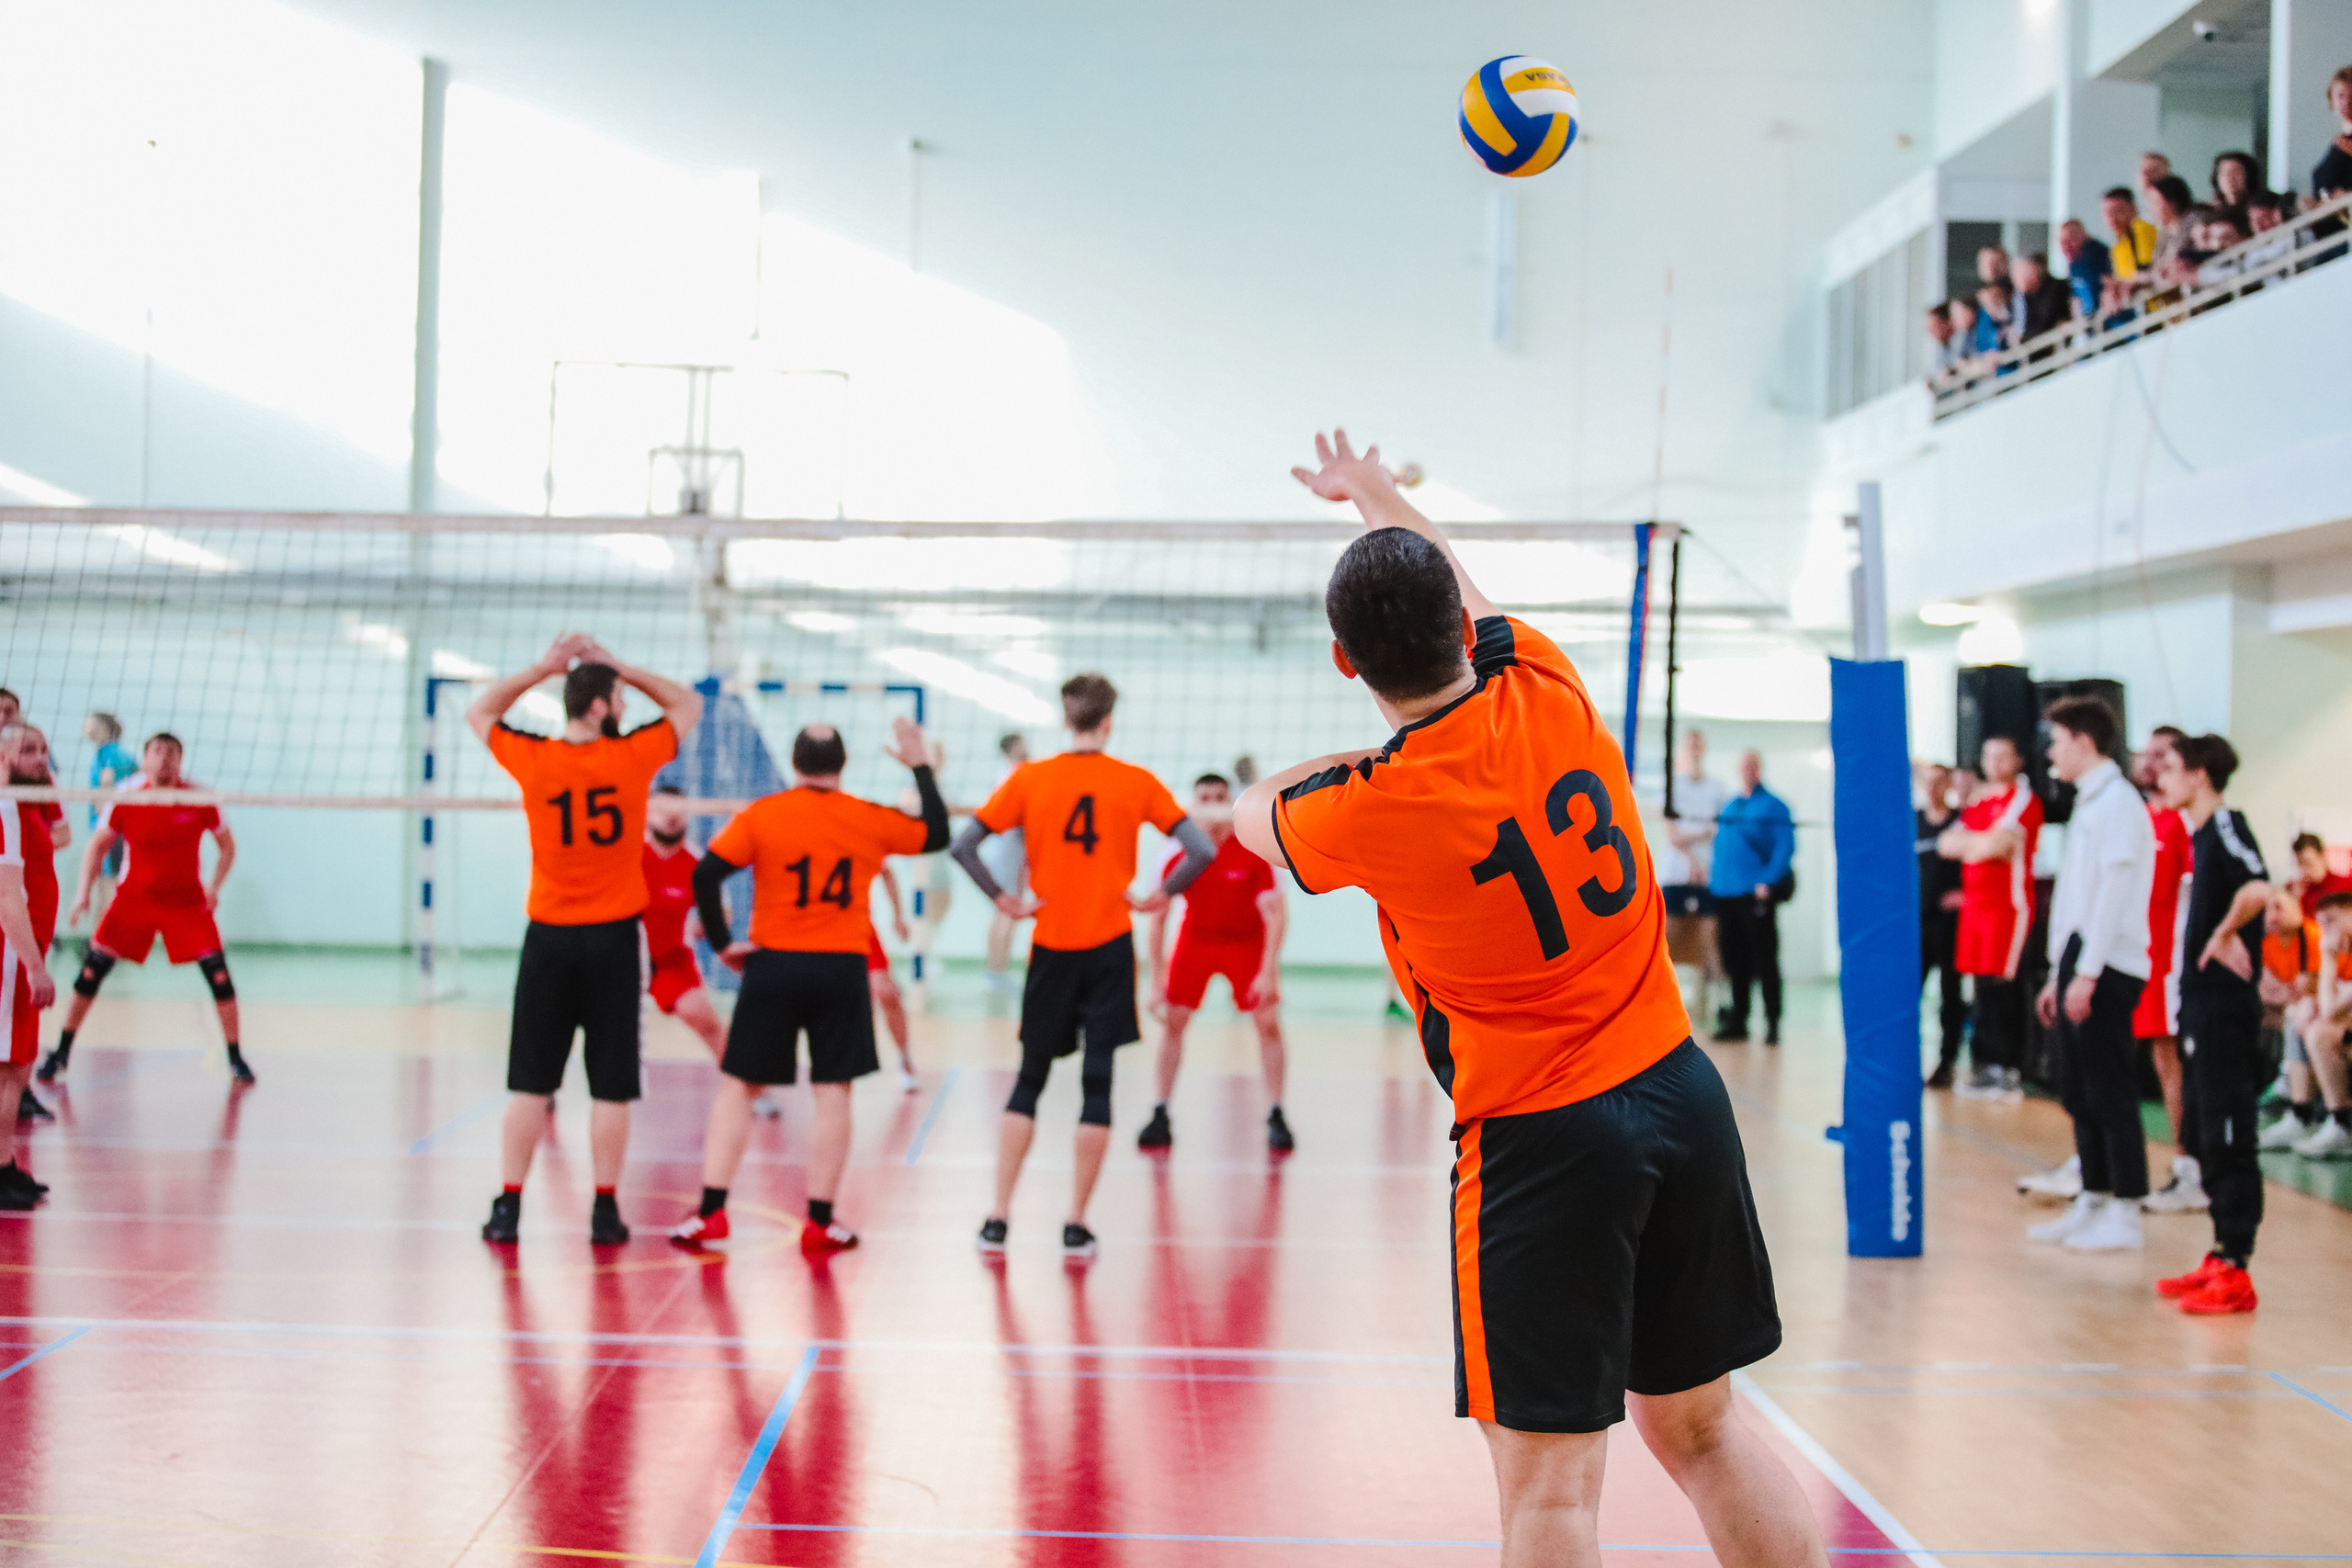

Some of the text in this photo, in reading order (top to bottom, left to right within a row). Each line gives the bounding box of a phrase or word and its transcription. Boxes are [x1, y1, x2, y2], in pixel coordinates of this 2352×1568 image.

[548, 786, 624, 847] 15
[1064, 795, 1098, 854] 4
[786, 855, 853, 909] 14
[1470, 770, 1636, 961] 13
